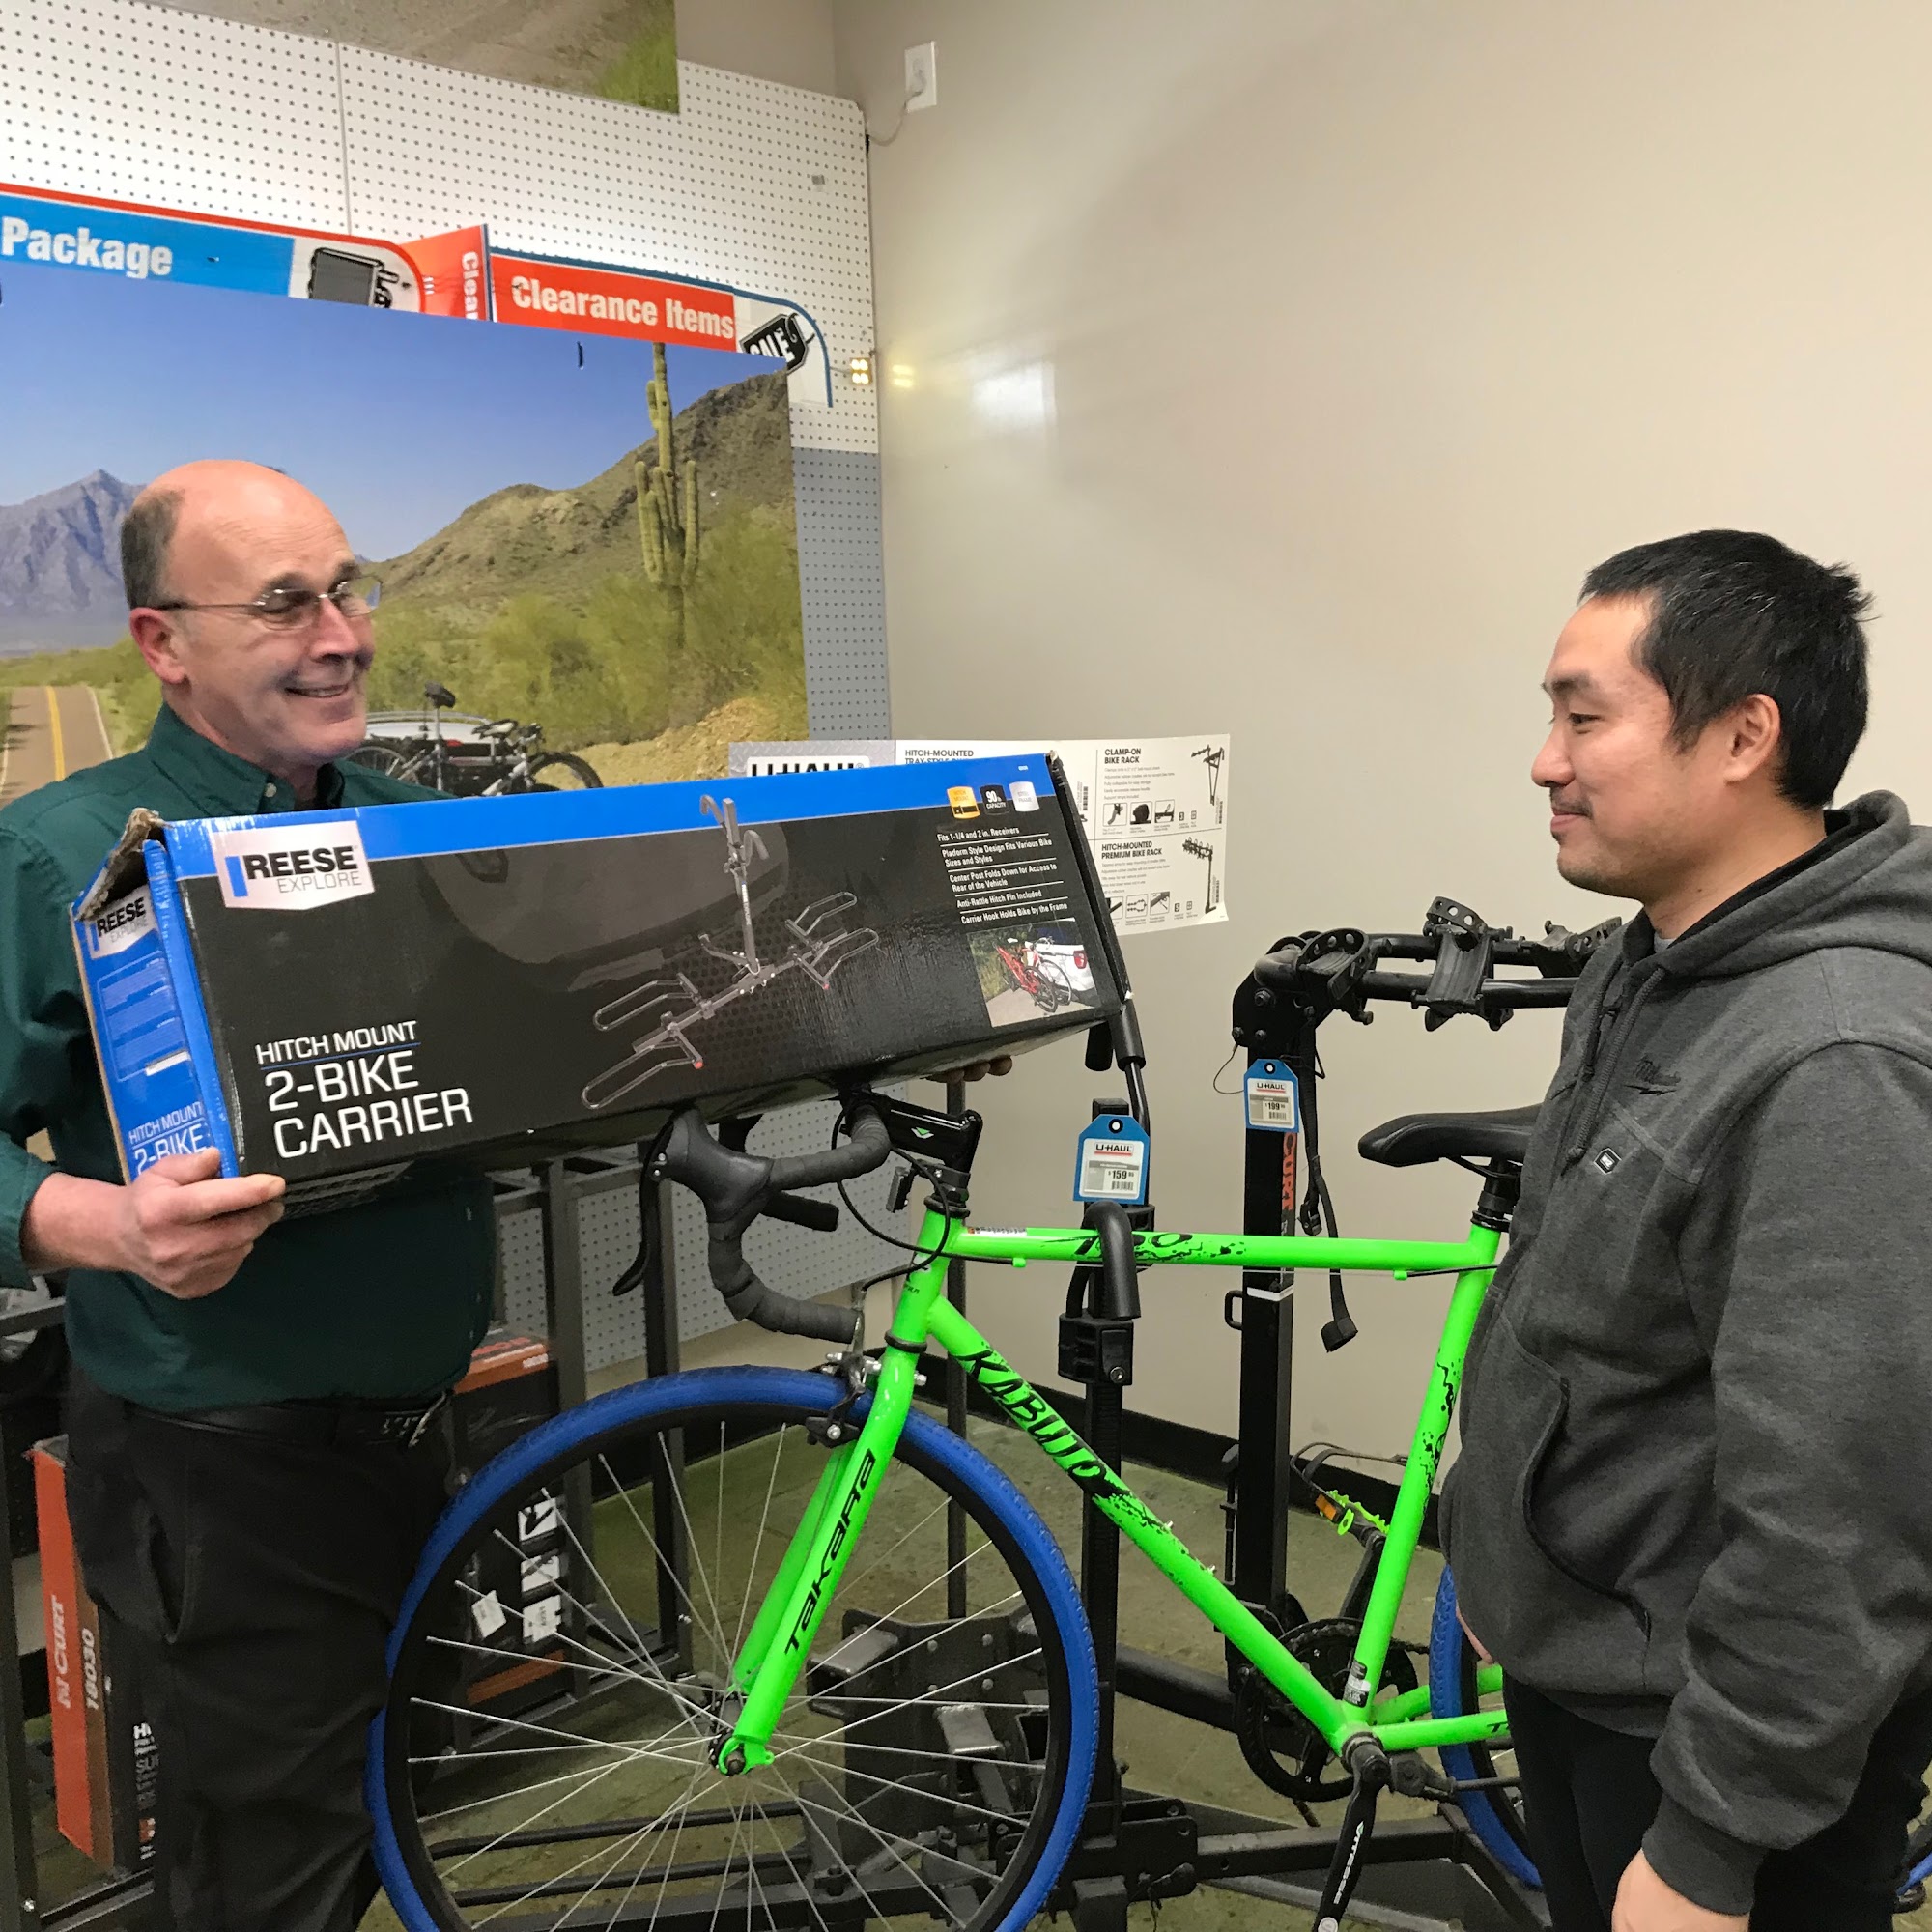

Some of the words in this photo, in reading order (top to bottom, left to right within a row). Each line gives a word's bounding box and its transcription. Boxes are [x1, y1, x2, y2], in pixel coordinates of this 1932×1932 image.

[2, 216, 173, 278] Package
[511, 275, 658, 327] Clearance
[666, 298, 734, 339] Items
[904, 749, 975, 757] HITCH-MOUNTED
[1104, 748, 1142, 756] CLAMP-ON
[1121, 755, 1140, 764] RACK
[990, 827, 1019, 837] Receivers
[942, 848, 968, 858] Platform
[968, 846, 984, 856] Style
[984, 844, 1006, 854] Design
[1016, 840, 1038, 849] Various
[1101, 841, 1152, 851] HITCH-MOUNTED
[1101, 850, 1131, 860] PREMIUM
[1132, 849, 1146, 858] BIKE
[1146, 848, 1162, 857] RACK
[242, 845, 358, 880] REESE
[944, 859, 962, 867] Sizes
[962, 857, 974, 866] and
[974, 855, 993, 865] Styles
[276, 871, 362, 894] EXPLORE
[949, 873, 970, 883] Center
[971, 871, 985, 881] Post
[984, 869, 1002, 878] Folds
[1002, 867, 1019, 876] Down
[1028, 865, 1050, 873] Access
[952, 884, 967, 893] Rear
[985, 879, 1009, 888] Vehicle
[956, 896, 989, 908] Anti-Rattle
[989, 894, 1007, 903] Hitch
[1006, 893, 1016, 901] Pin
[1016, 890, 1042, 900] Included
[98, 896, 146, 937] REESE
[961, 915, 983, 924] Carrier
[983, 912, 1000, 922] Hook
[1000, 910, 1017, 919] Holds
[1017, 908, 1031, 917] Bike
[1049, 902, 1067, 911] Frame
[255, 1035, 329, 1065] HITCH
[333, 1020, 417, 1052] MOUNT
[265, 1050, 419, 1112] 2-BIKE
[128, 1121, 160, 1145] HITCH
[161, 1101, 204, 1129] MOUNT
[274, 1088, 473, 1159] CARRIER
[1095, 1144, 1132, 1152] U-HAUL
